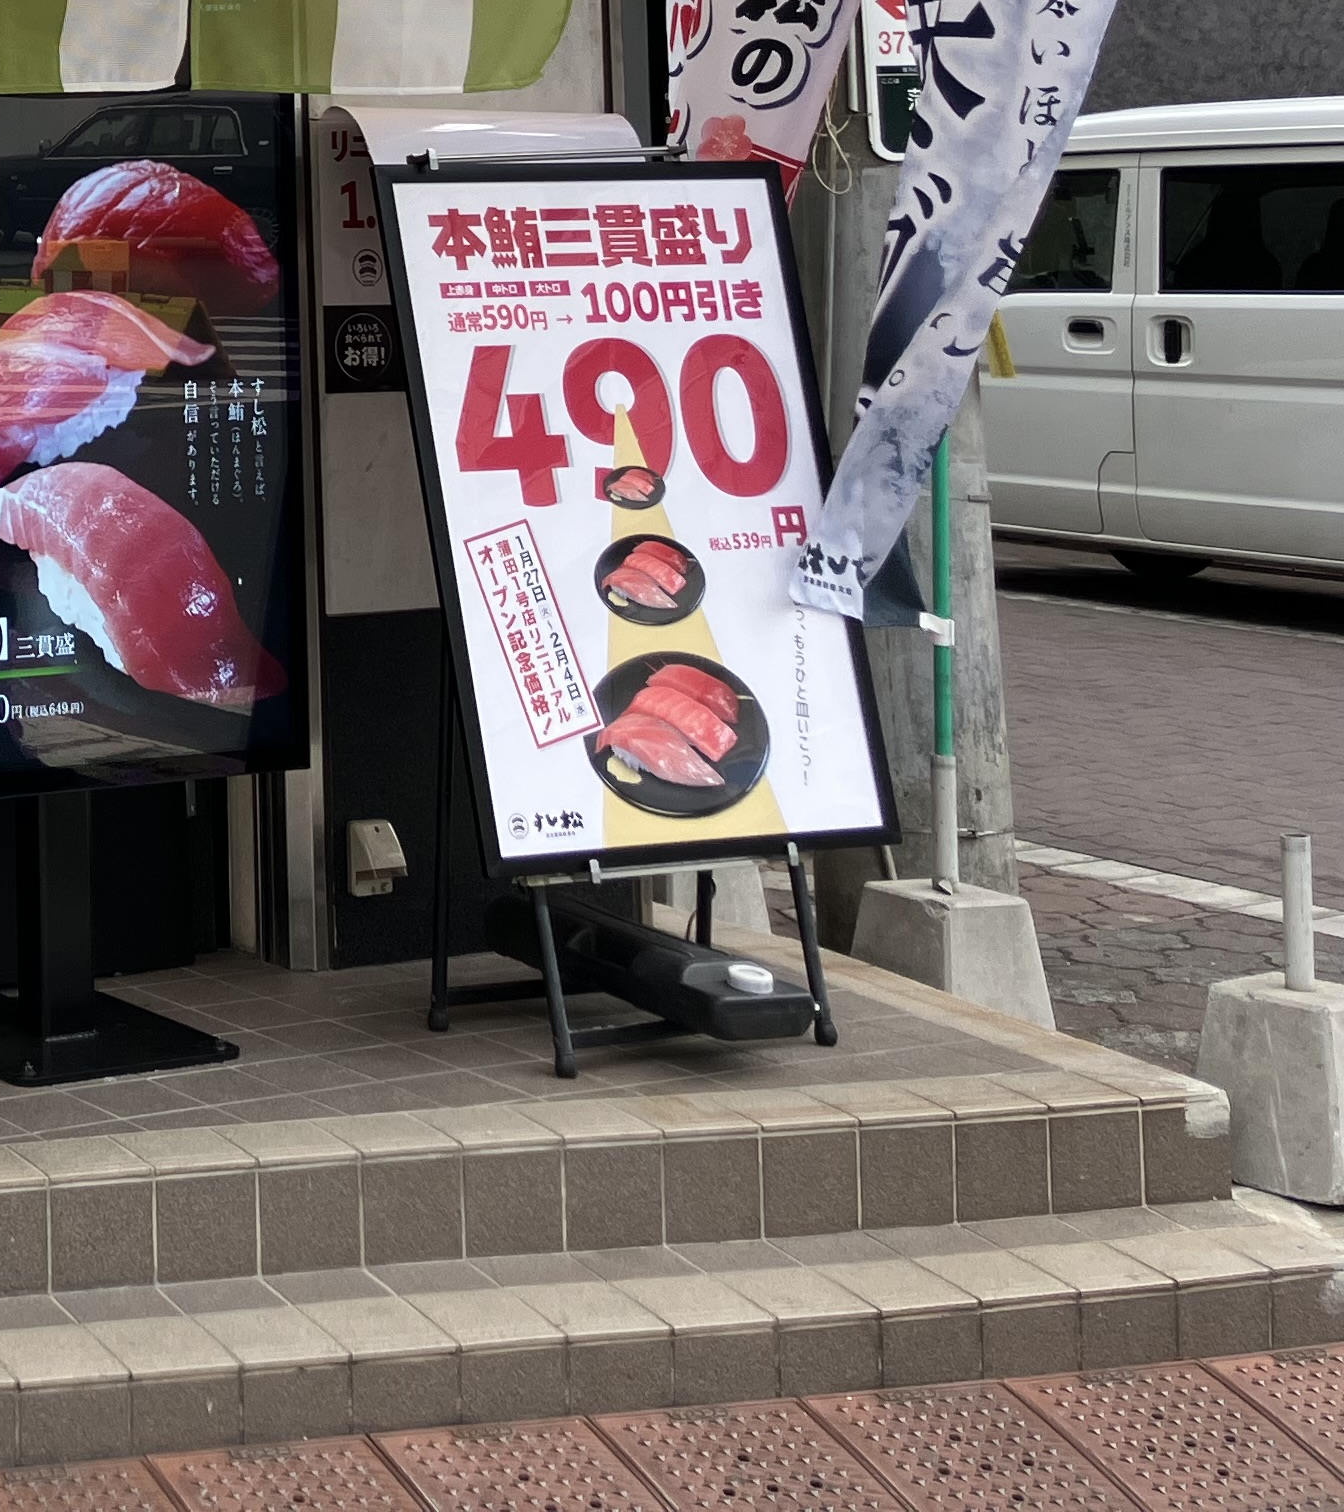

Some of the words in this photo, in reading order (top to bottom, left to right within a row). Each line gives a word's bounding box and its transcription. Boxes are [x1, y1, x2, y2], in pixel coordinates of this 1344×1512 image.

[878, 31, 914, 55] 37
[427, 204, 754, 272] 本鮪三貫盛り
[446, 284, 474, 296] 上赤身
[492, 283, 518, 295] 中トロ
[535, 282, 562, 294] 大トロ
[447, 303, 548, 333] 通常590円
[581, 279, 764, 324] 100円引き
[343, 346, 386, 367] お得!
[455, 333, 791, 507] 490
[708, 531, 773, 552] 税込539円
[478, 544, 554, 737] オープン記念価格!
[496, 539, 572, 725] 蒲田1号店リニューアル
[15, 633, 76, 660] 三貫盛
[533, 810, 584, 833] すし松
